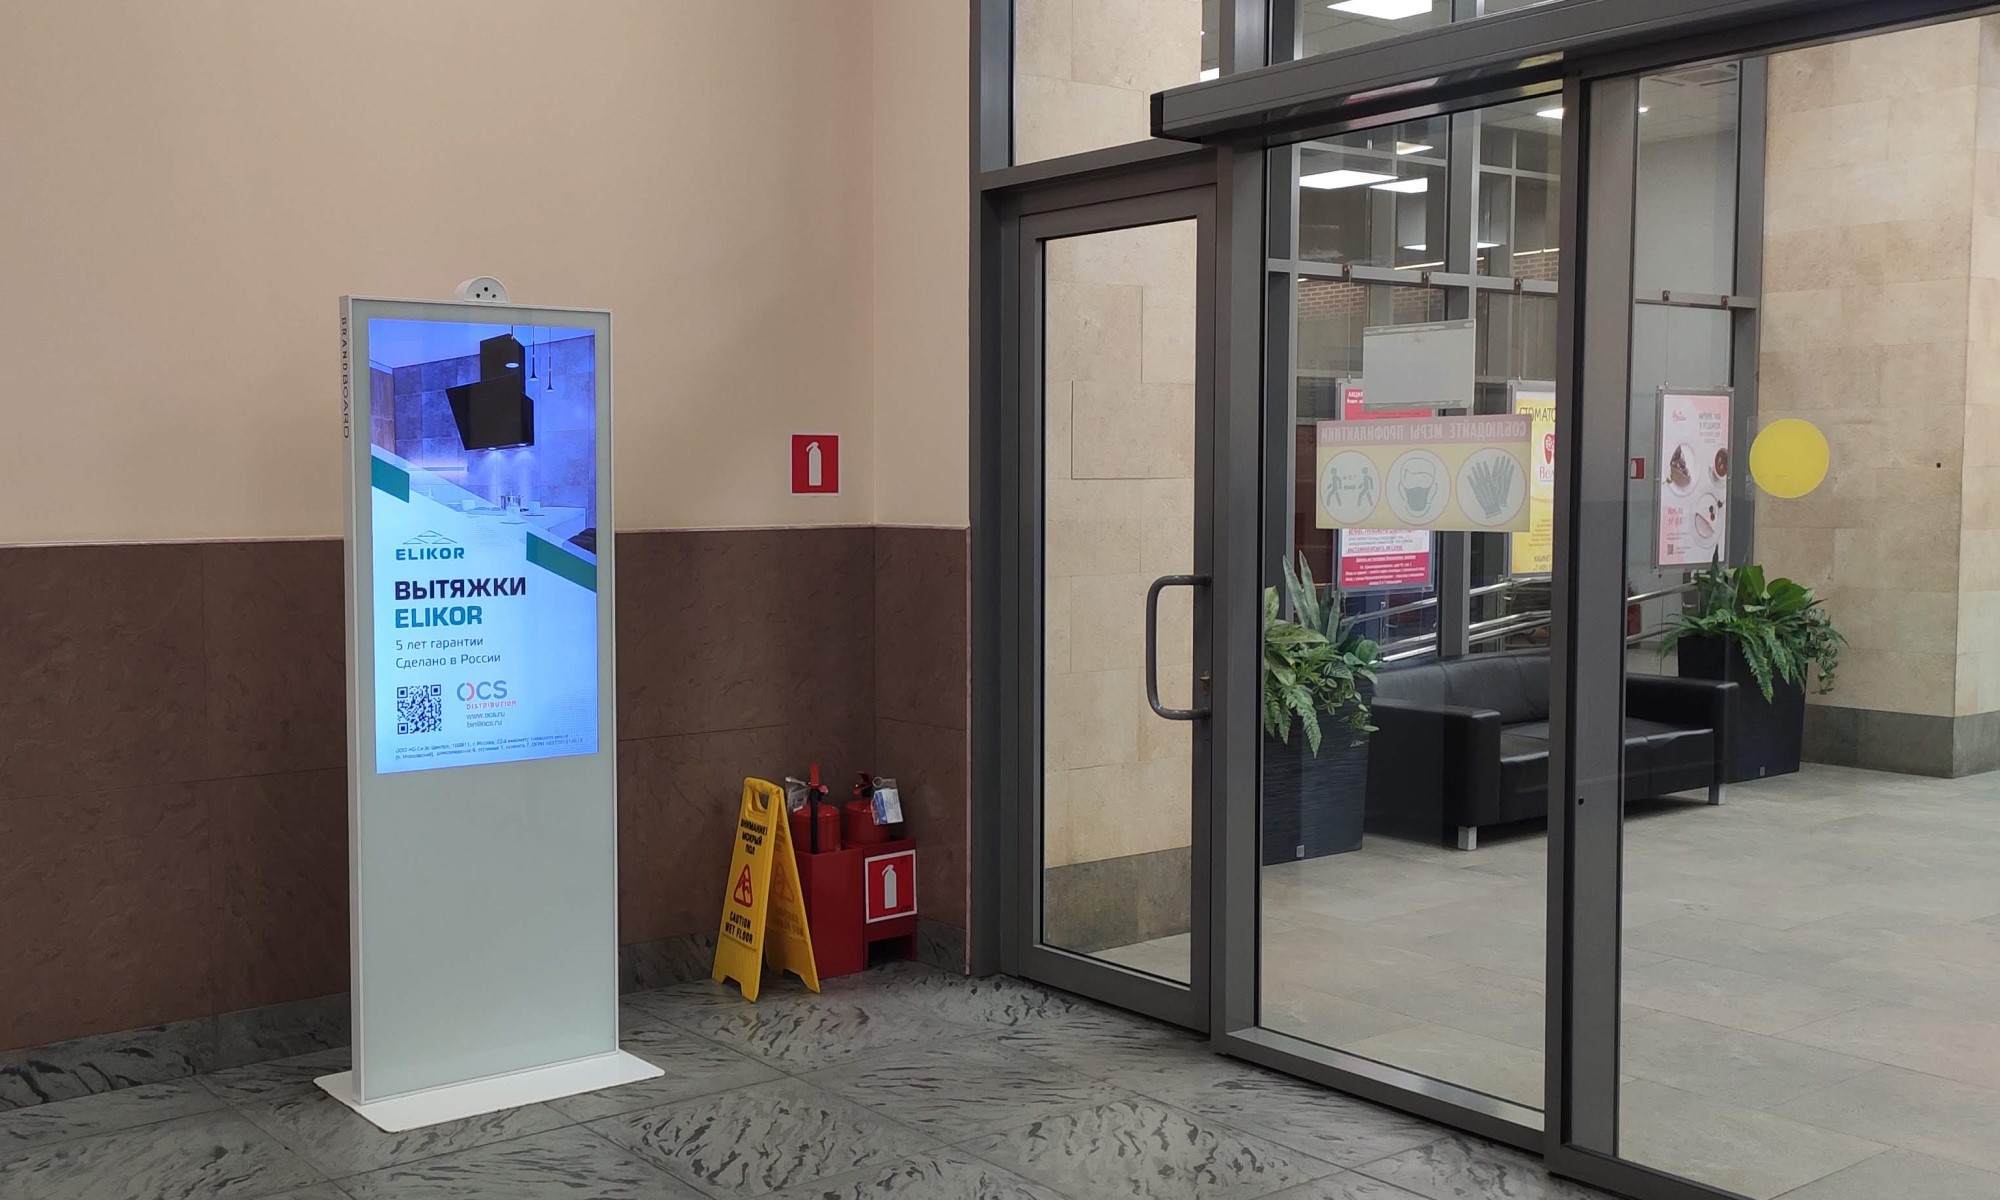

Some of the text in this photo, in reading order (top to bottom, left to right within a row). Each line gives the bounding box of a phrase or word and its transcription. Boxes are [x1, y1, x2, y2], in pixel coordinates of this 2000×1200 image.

[341, 317, 349, 439] BRANDBOARD
[395, 547, 465, 561] ELIKOR
[394, 576, 527, 601] ВЫТЯЖКИ
[395, 605, 483, 629] ELIKOR
[396, 637, 484, 651] 5 лет гарантии
[395, 653, 501, 670] Сделано в России
[456, 679, 508, 702] OCS
[466, 700, 517, 710] DISTRIBUTION
[742, 831, 763, 846] МОКРЫЙ
[745, 844, 756, 855] ПОЛ
[730, 911, 752, 930] CAUTION
[725, 922, 753, 944] WET FLOOR
